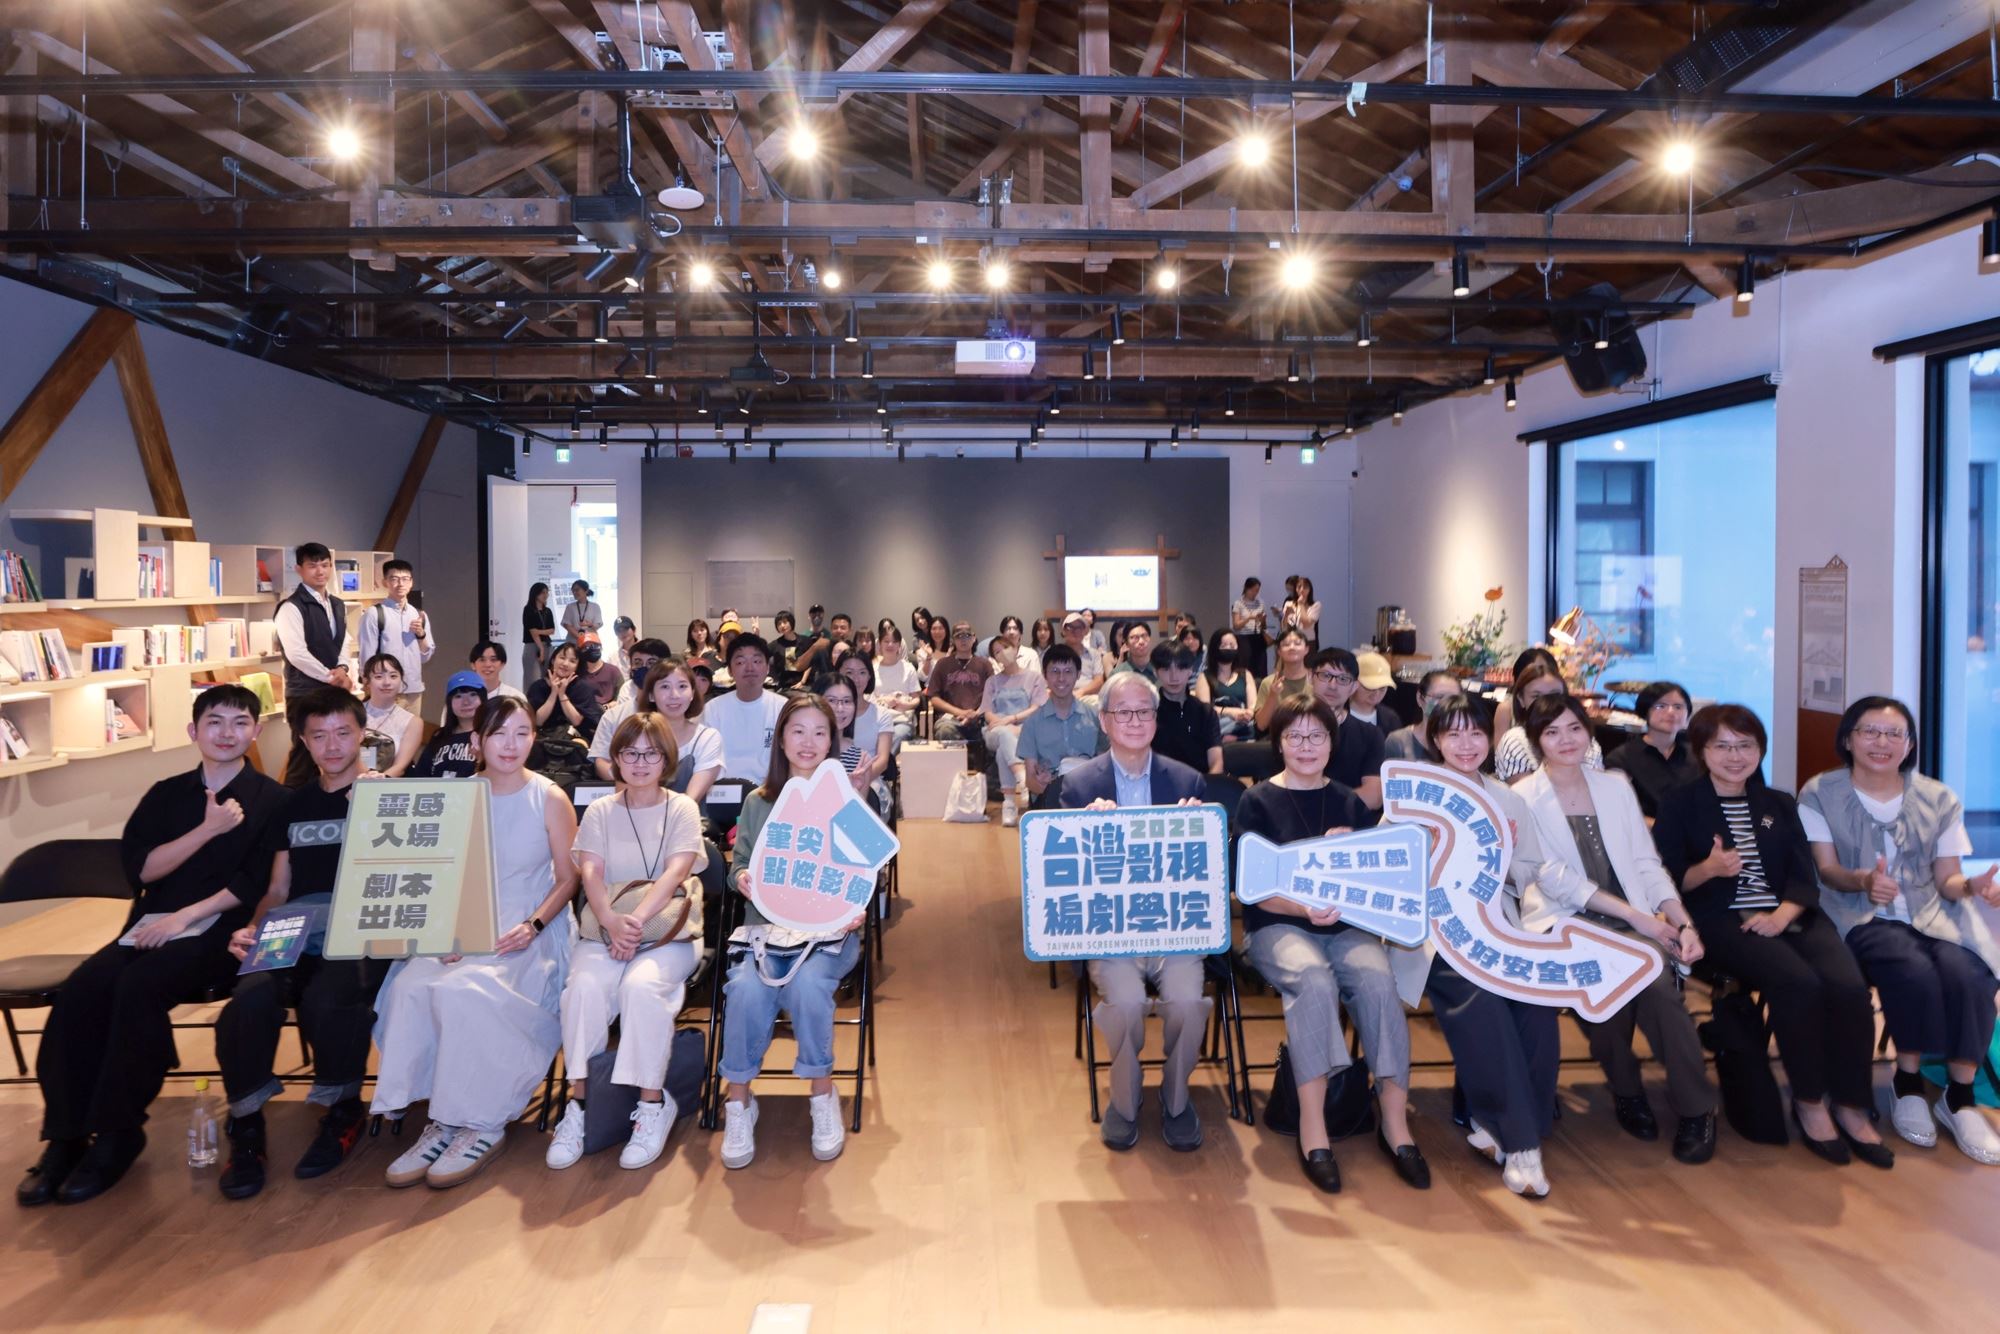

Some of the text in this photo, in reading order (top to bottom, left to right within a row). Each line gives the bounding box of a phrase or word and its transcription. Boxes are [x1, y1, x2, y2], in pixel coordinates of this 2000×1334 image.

[376, 792, 446, 818] 靈感
[372, 822, 441, 848] 入場
[765, 821, 825, 856] 筆尖
[1130, 817, 1205, 839] 2025
[1042, 822, 1210, 888] 台灣影視
[1302, 849, 1409, 871] 人生如戲
[361, 872, 433, 899] 劇本
[357, 903, 428, 930] 出場
[1043, 890, 1212, 937] 編劇學院
[1047, 936, 1210, 951] TAIWAN SCREENWRITERS INSTITUTE
